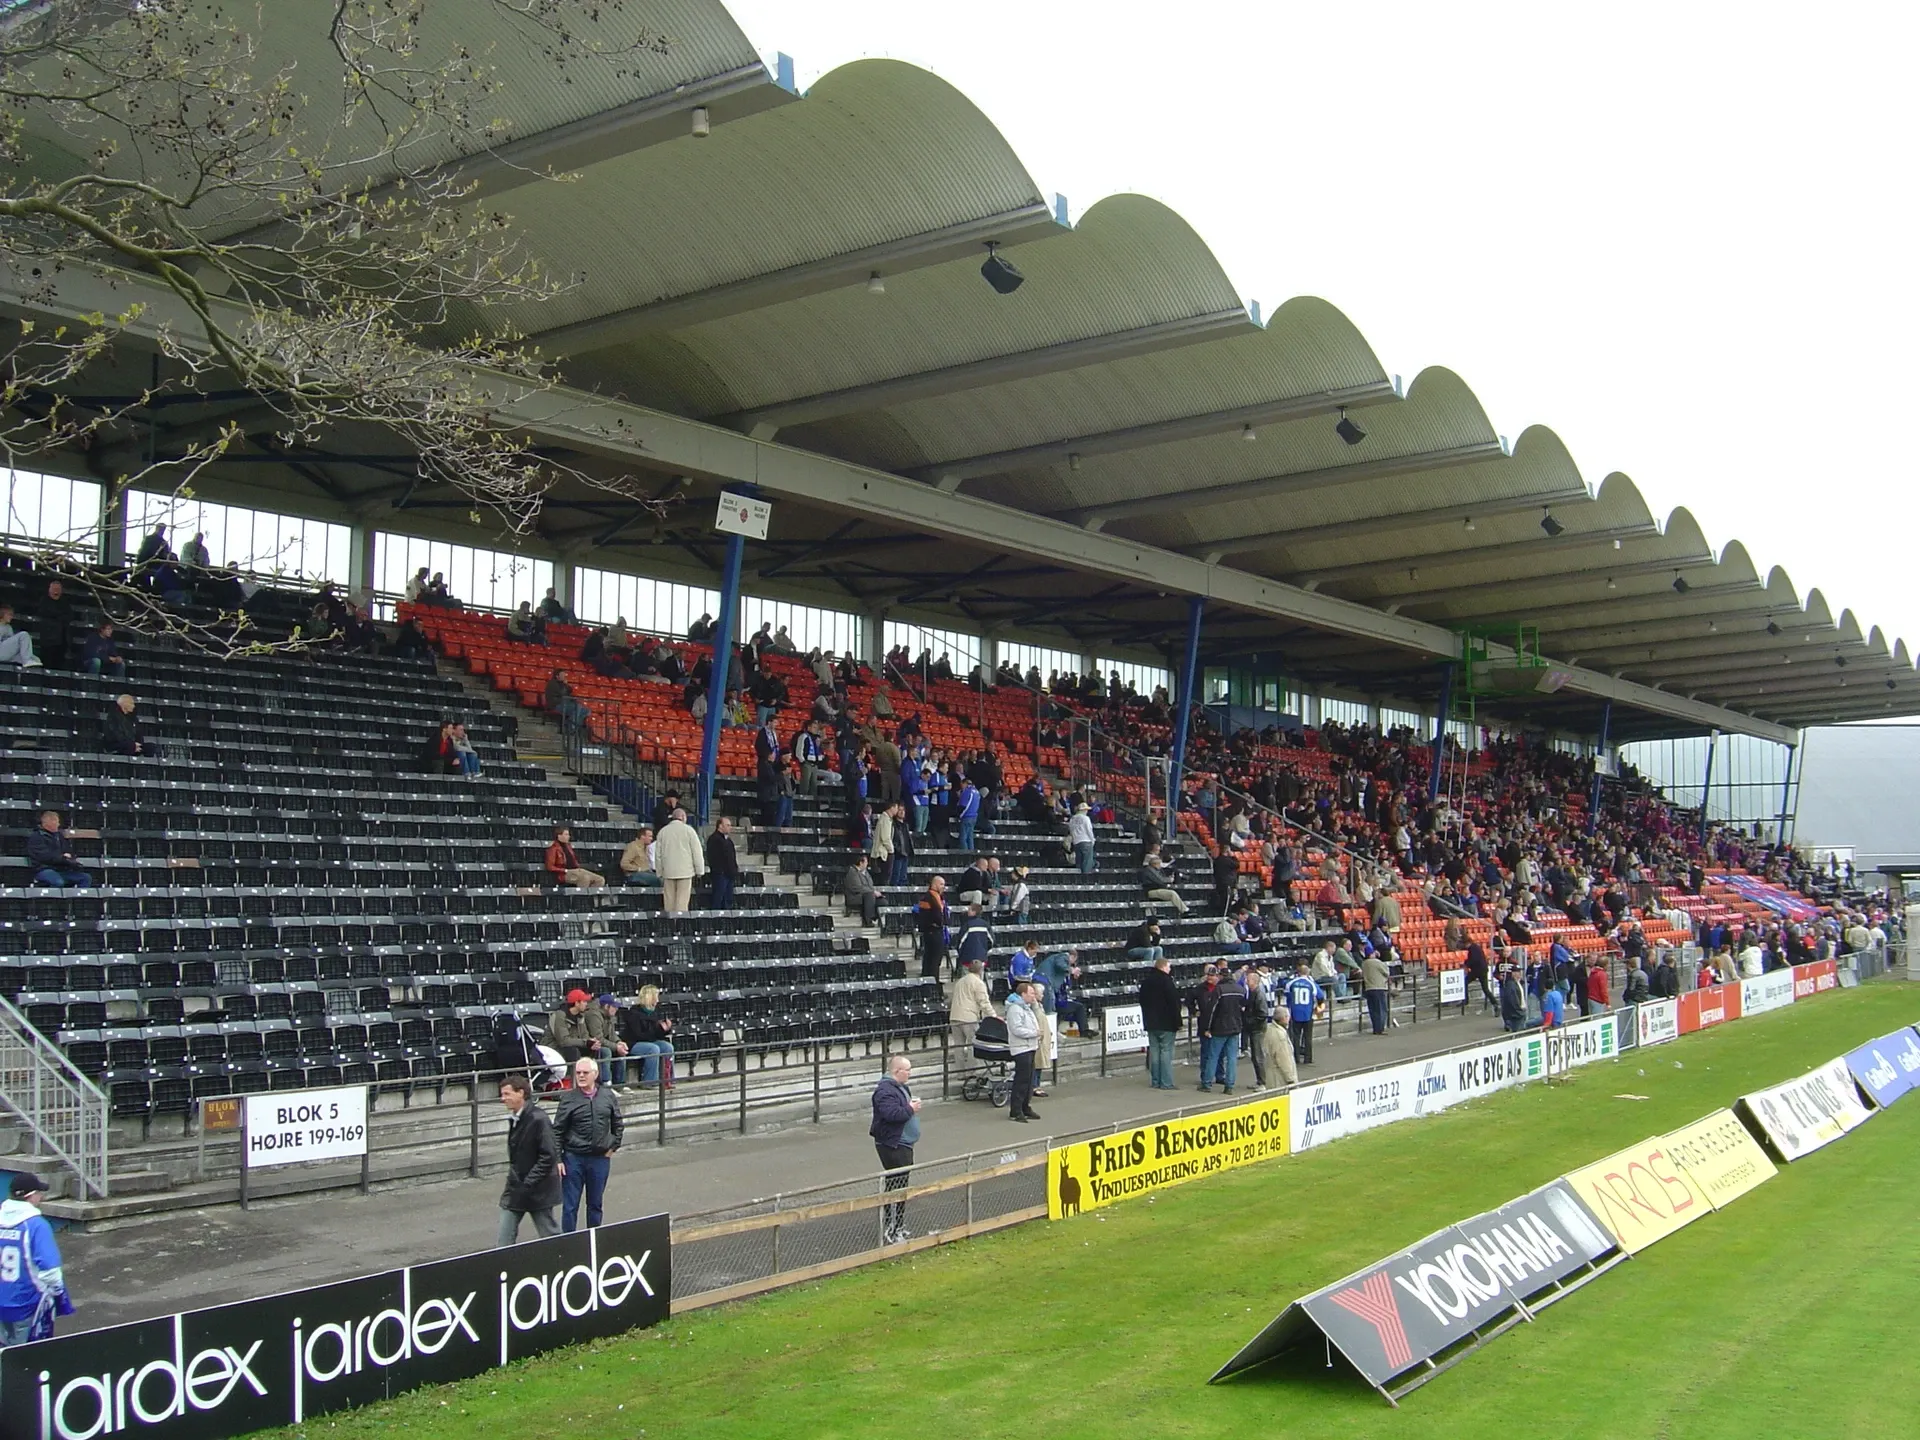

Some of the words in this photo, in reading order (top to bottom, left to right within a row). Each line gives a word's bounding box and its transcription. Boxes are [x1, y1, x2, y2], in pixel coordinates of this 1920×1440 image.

[1294, 987, 1310, 1004] 10
[1117, 1016, 1134, 1026] BLOK
[1136, 1014, 1140, 1024] 3
[1584, 1030, 1596, 1056] A/S
[1459, 1059, 1480, 1091] KPC
[1484, 1054, 1504, 1084] BYG
[1507, 1048, 1522, 1078] A/S
[1356, 1089, 1366, 1106] 70
[1368, 1086, 1376, 1102] 15
[1380, 1084, 1388, 1100] 22
[1391, 1080, 1400, 1097] 22
[1417, 1074, 1446, 1098] ALTIMA
[278, 1104, 322, 1124] BLOK
[330, 1103, 338, 1120] 5
[1260, 1109, 1280, 1133] OG
[1305, 1101, 1342, 1128] ALTIMA
[1356, 1099, 1400, 1120] www.altima.dk
[252, 1131, 302, 1151] HØJRE
[310, 1125, 364, 1144] 199-169
[1666, 1140, 1706, 1172] AROS
[1699, 1120, 1750, 1156] REJSER
[1202, 1154, 1222, 1173] APS
[1230, 1148, 1240, 1164] 70
[1244, 1144, 1254, 1160] 20
[1258, 1140, 1268, 1156] 21
[1270, 1136, 1281, 1152] 46
[1592, 1149, 1693, 1244] AROS
[1395, 1212, 1574, 1326] YOKOHAMA
[500, 1228, 654, 1365] jardex
[294, 1268, 480, 1423] jardex
[41, 1313, 268, 1440] jardex
